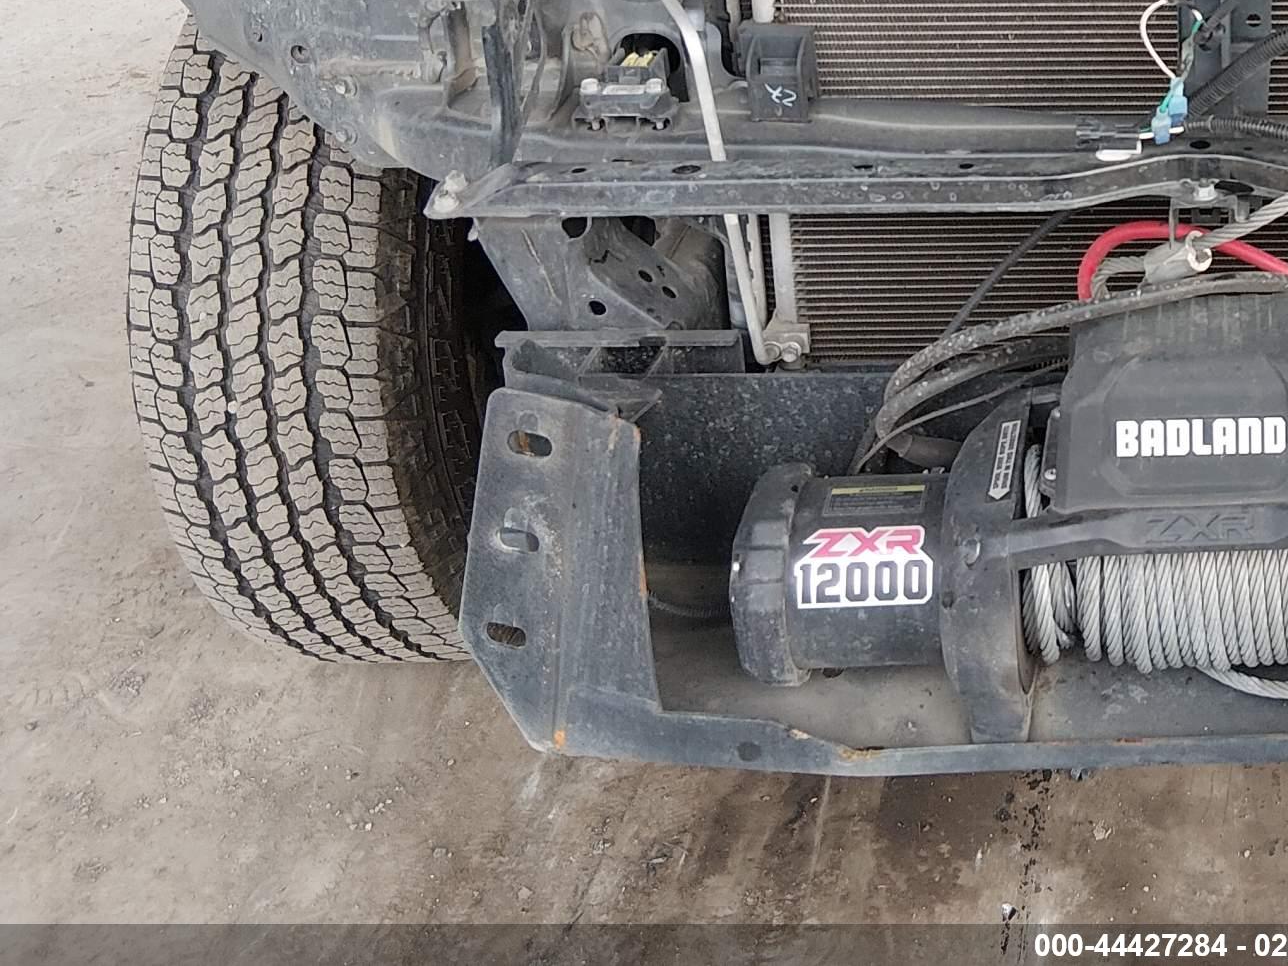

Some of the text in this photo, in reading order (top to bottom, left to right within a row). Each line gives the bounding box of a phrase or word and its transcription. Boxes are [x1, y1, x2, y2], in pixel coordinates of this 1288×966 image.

[1115, 416, 1287, 458] BADLAND
[807, 527, 922, 559] ZXR
[1146, 509, 1255, 543] ZXR
[799, 559, 928, 604] 12000
